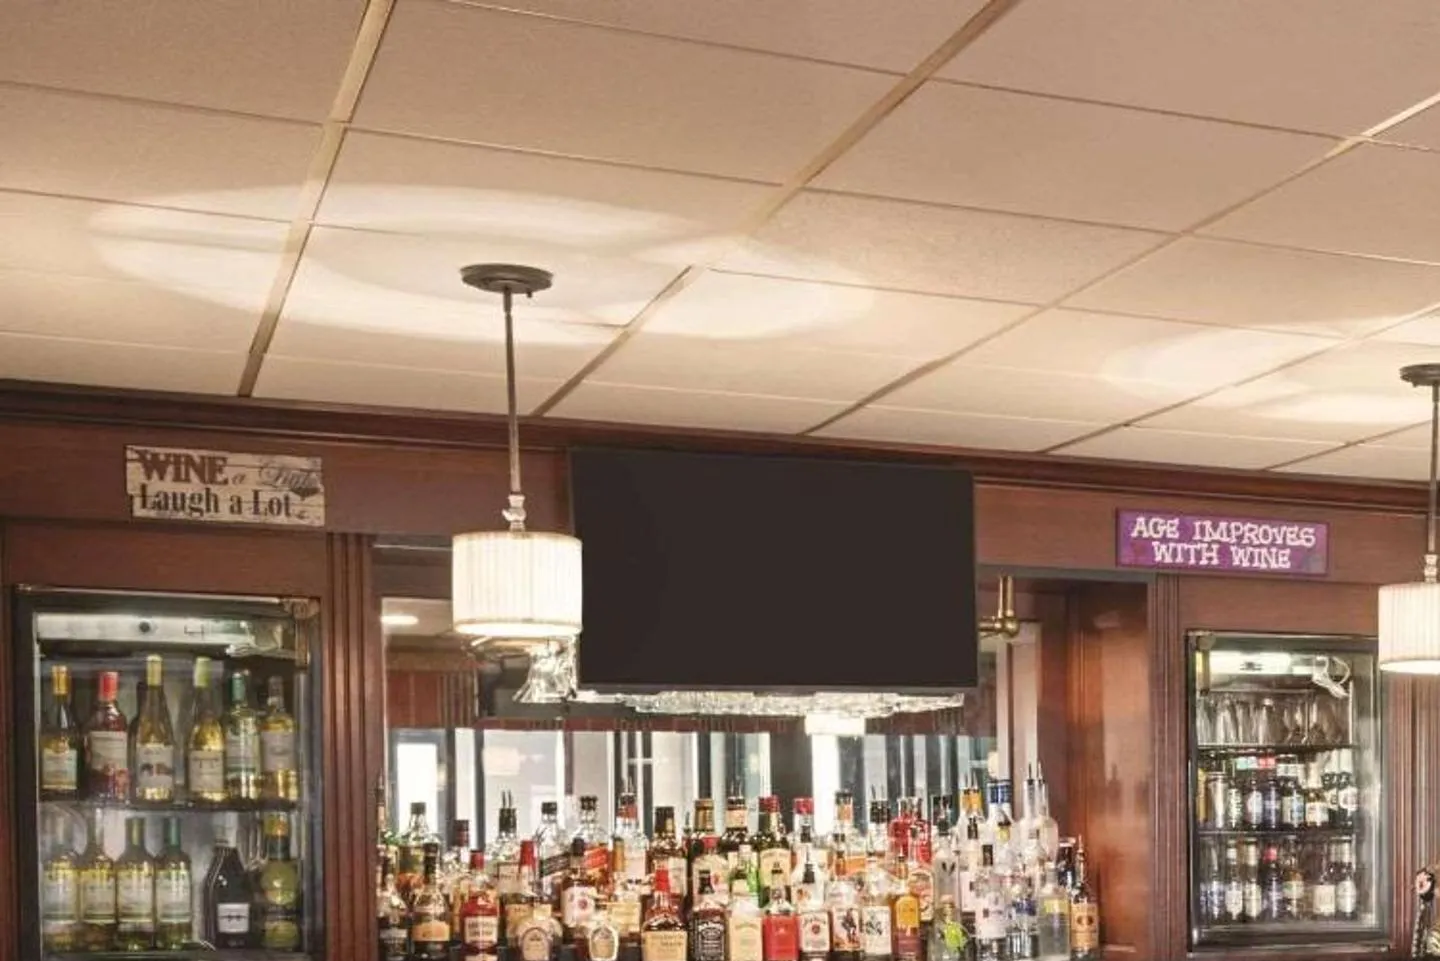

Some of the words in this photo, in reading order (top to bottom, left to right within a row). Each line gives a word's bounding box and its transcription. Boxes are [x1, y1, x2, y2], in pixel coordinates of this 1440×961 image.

[132, 449, 229, 486] WINE
[139, 483, 219, 516] Laugh
[229, 494, 243, 515] a
[251, 489, 292, 517] Lot
[1131, 517, 1180, 539] AGE
[1193, 520, 1316, 547] IMPROVES
[1152, 541, 1220, 565] WITH
[1230, 546, 1291, 569] WINE
